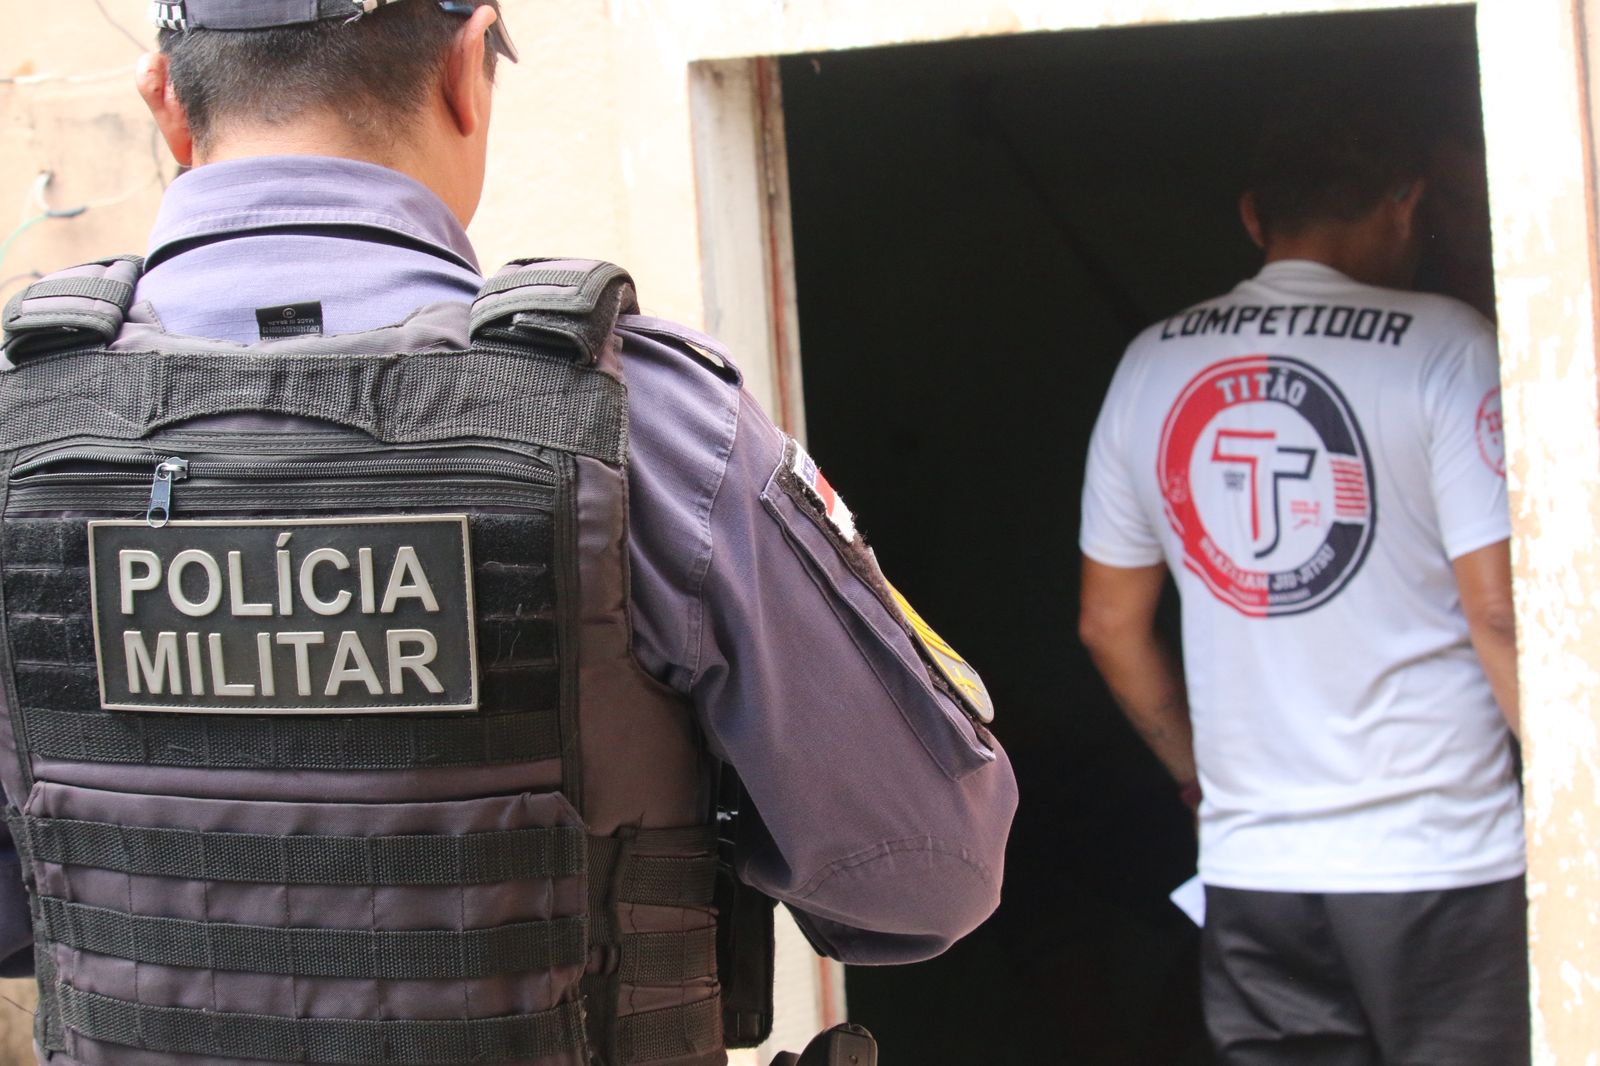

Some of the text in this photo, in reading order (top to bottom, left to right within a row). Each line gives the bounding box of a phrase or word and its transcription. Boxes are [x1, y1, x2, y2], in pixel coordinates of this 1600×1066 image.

[1161, 305, 1414, 346] COMPETIDOR
[1215, 367, 1307, 407] TITÃO
[119, 532, 440, 617] POLÍCIA
[123, 629, 445, 697] MILITAR
